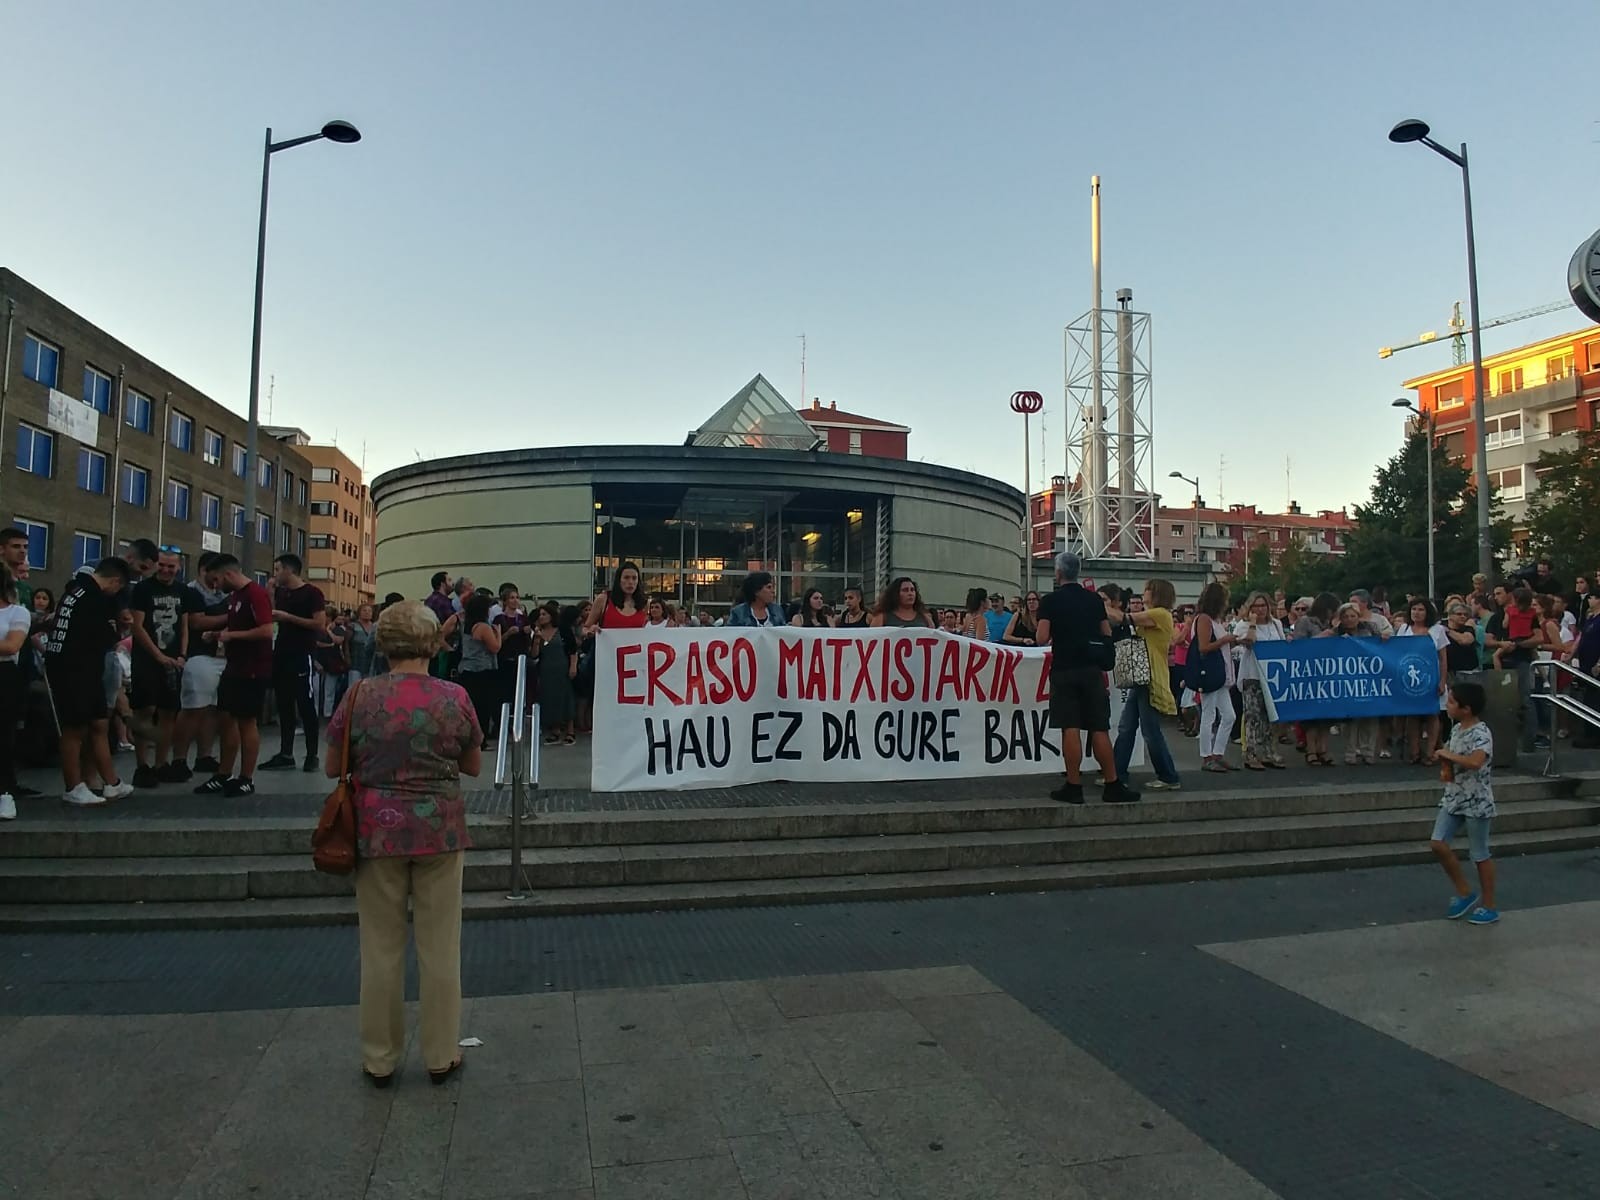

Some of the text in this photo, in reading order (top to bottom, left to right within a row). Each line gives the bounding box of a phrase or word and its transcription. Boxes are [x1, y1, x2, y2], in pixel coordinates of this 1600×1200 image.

[616, 637, 757, 706] ERASO
[777, 637, 1023, 704] MATXISTARIK
[644, 715, 731, 775] HAU
[752, 711, 803, 763] EZ
[822, 708, 861, 761] DA
[874, 708, 960, 762] GURE
